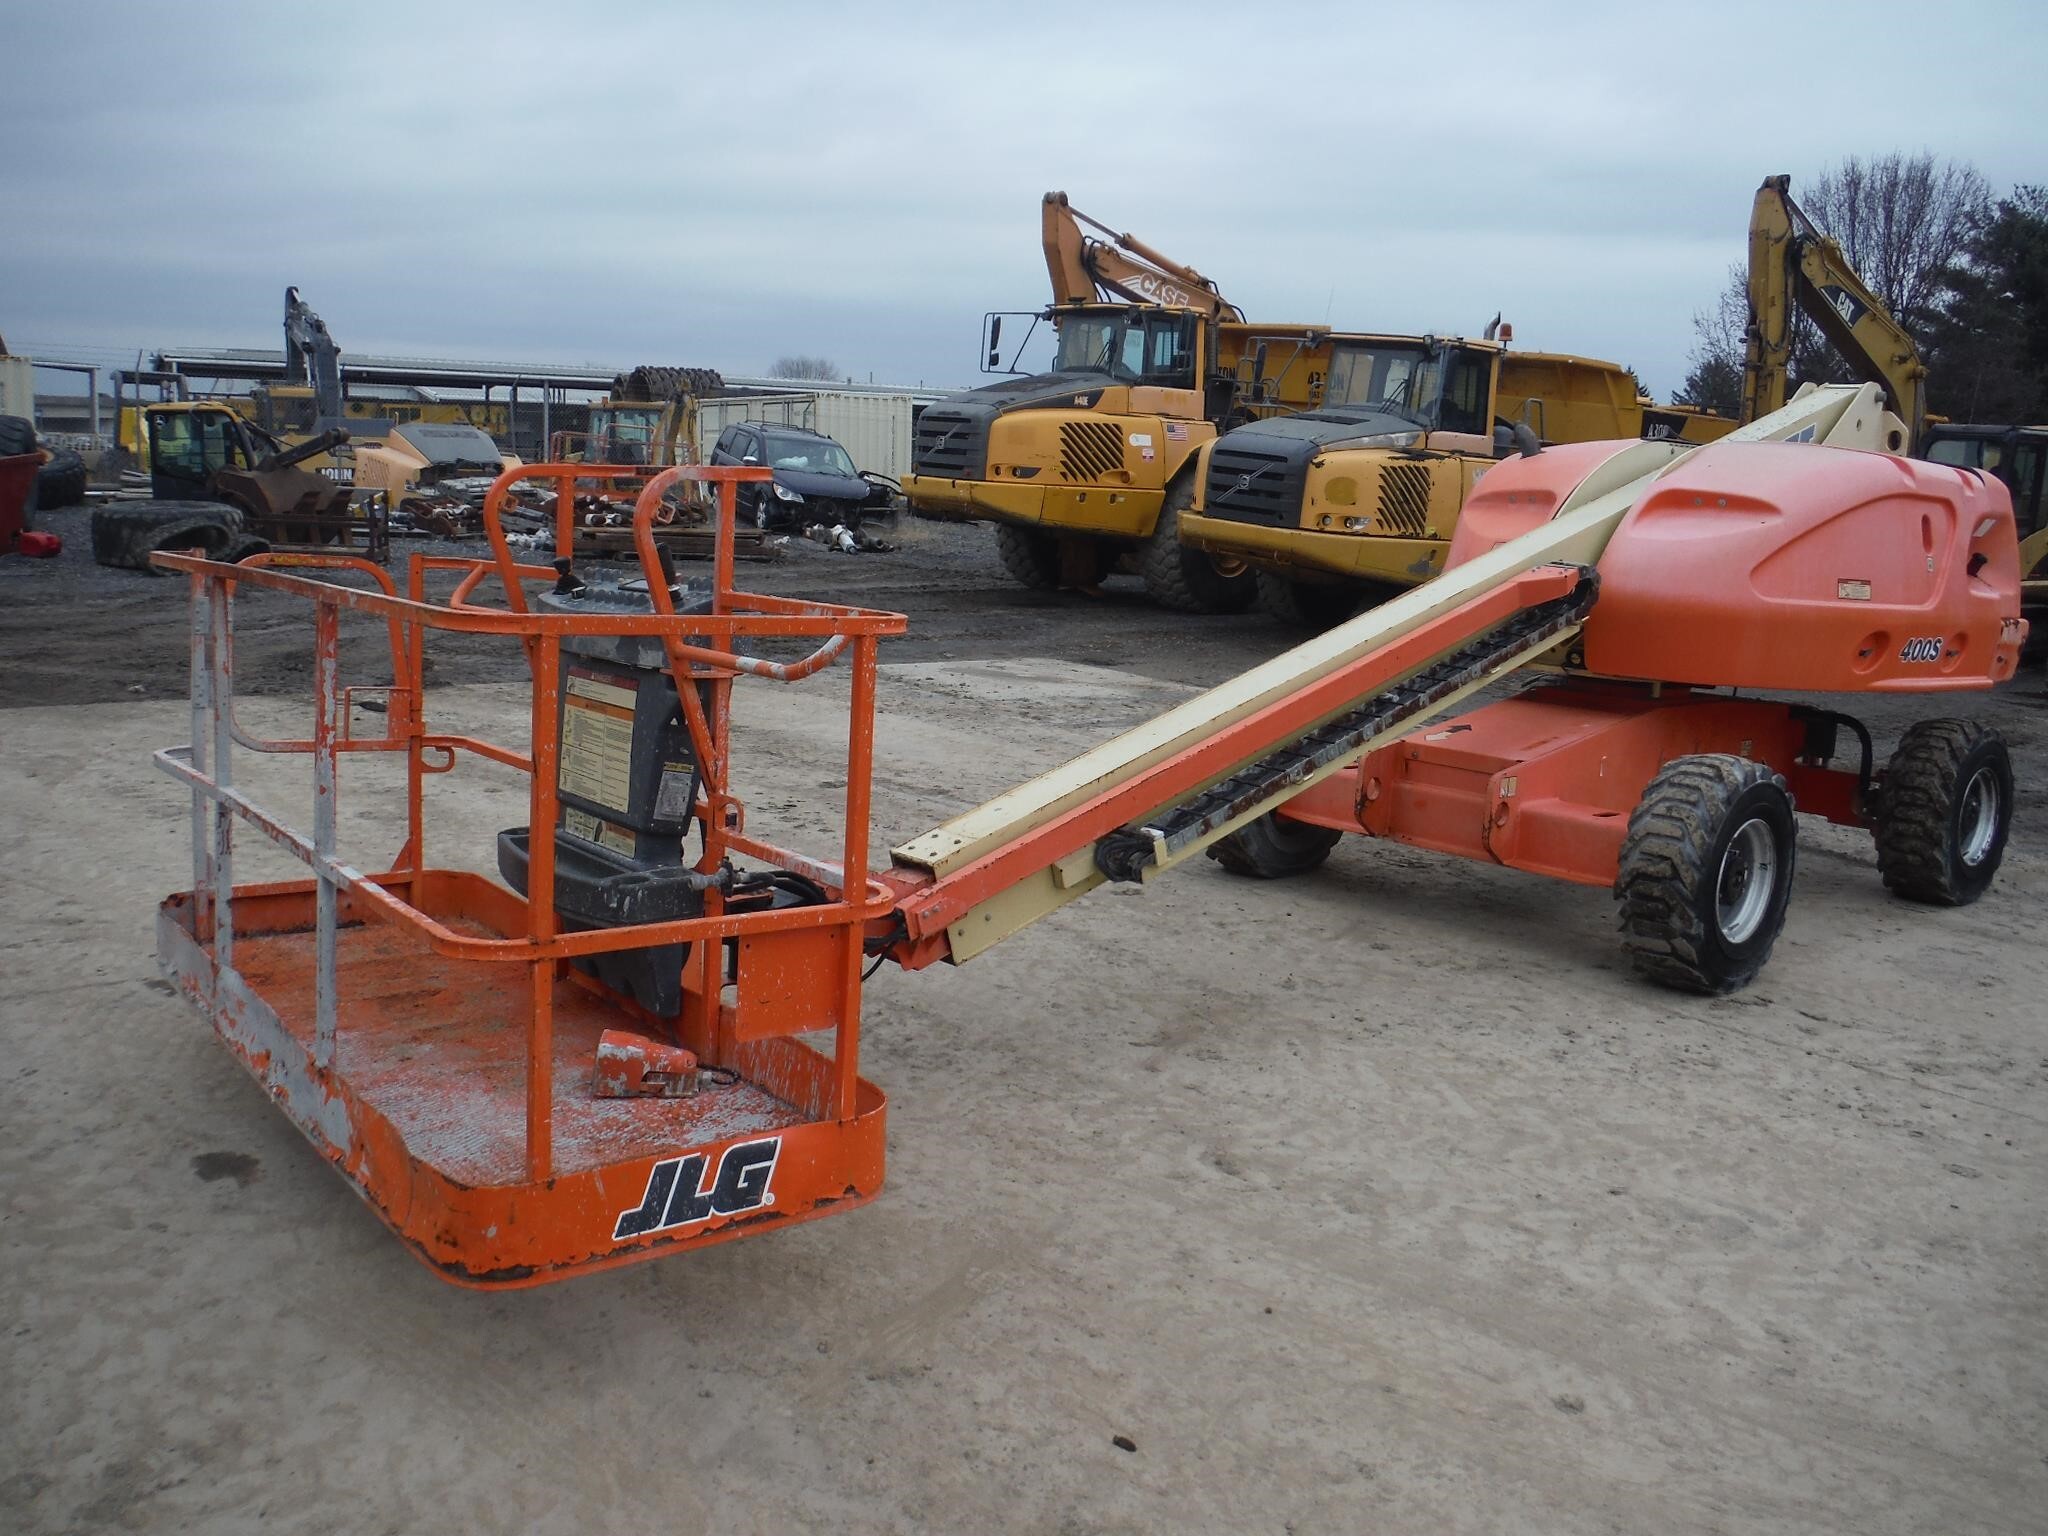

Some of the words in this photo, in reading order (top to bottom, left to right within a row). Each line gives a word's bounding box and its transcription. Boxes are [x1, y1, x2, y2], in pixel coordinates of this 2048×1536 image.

[1836, 291, 1855, 321] CAT
[1898, 637, 1943, 663] 400S
[612, 1135, 782, 1241] JLG
